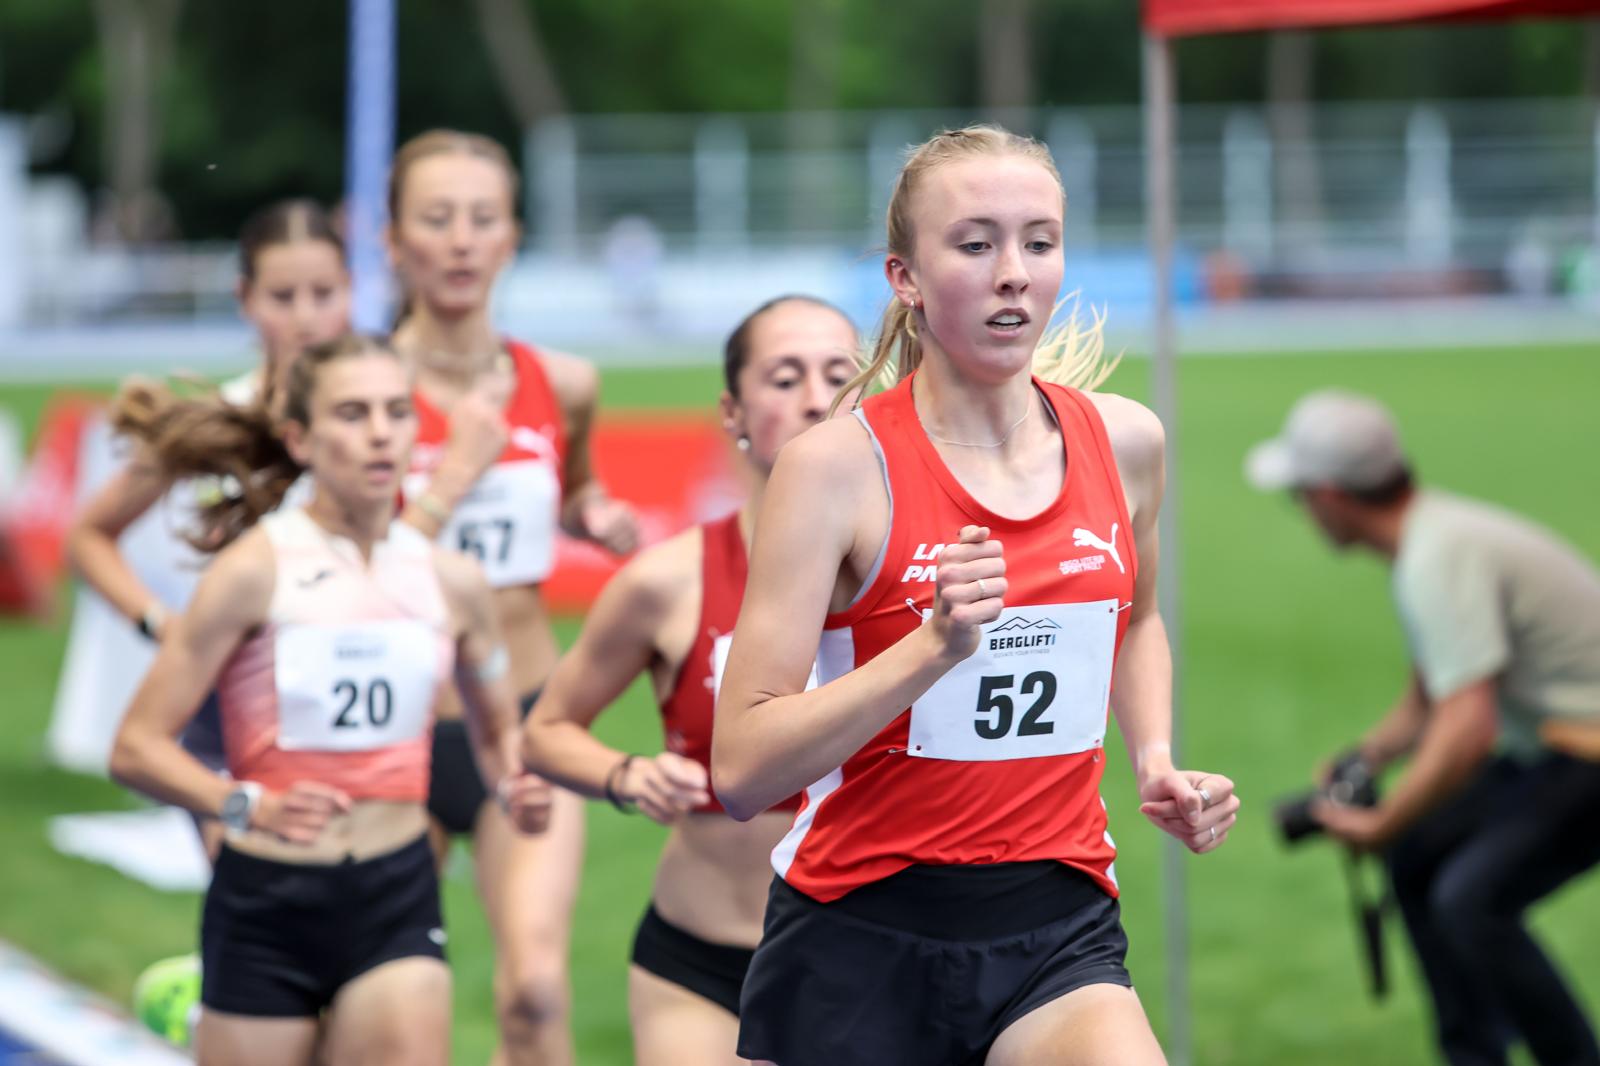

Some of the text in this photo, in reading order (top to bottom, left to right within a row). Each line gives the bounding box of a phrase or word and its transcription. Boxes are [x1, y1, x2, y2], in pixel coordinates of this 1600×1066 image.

[912, 543, 952, 560] LA
[900, 565, 939, 582] PA
[332, 680, 393, 729] 20
[975, 671, 1056, 739] 52
